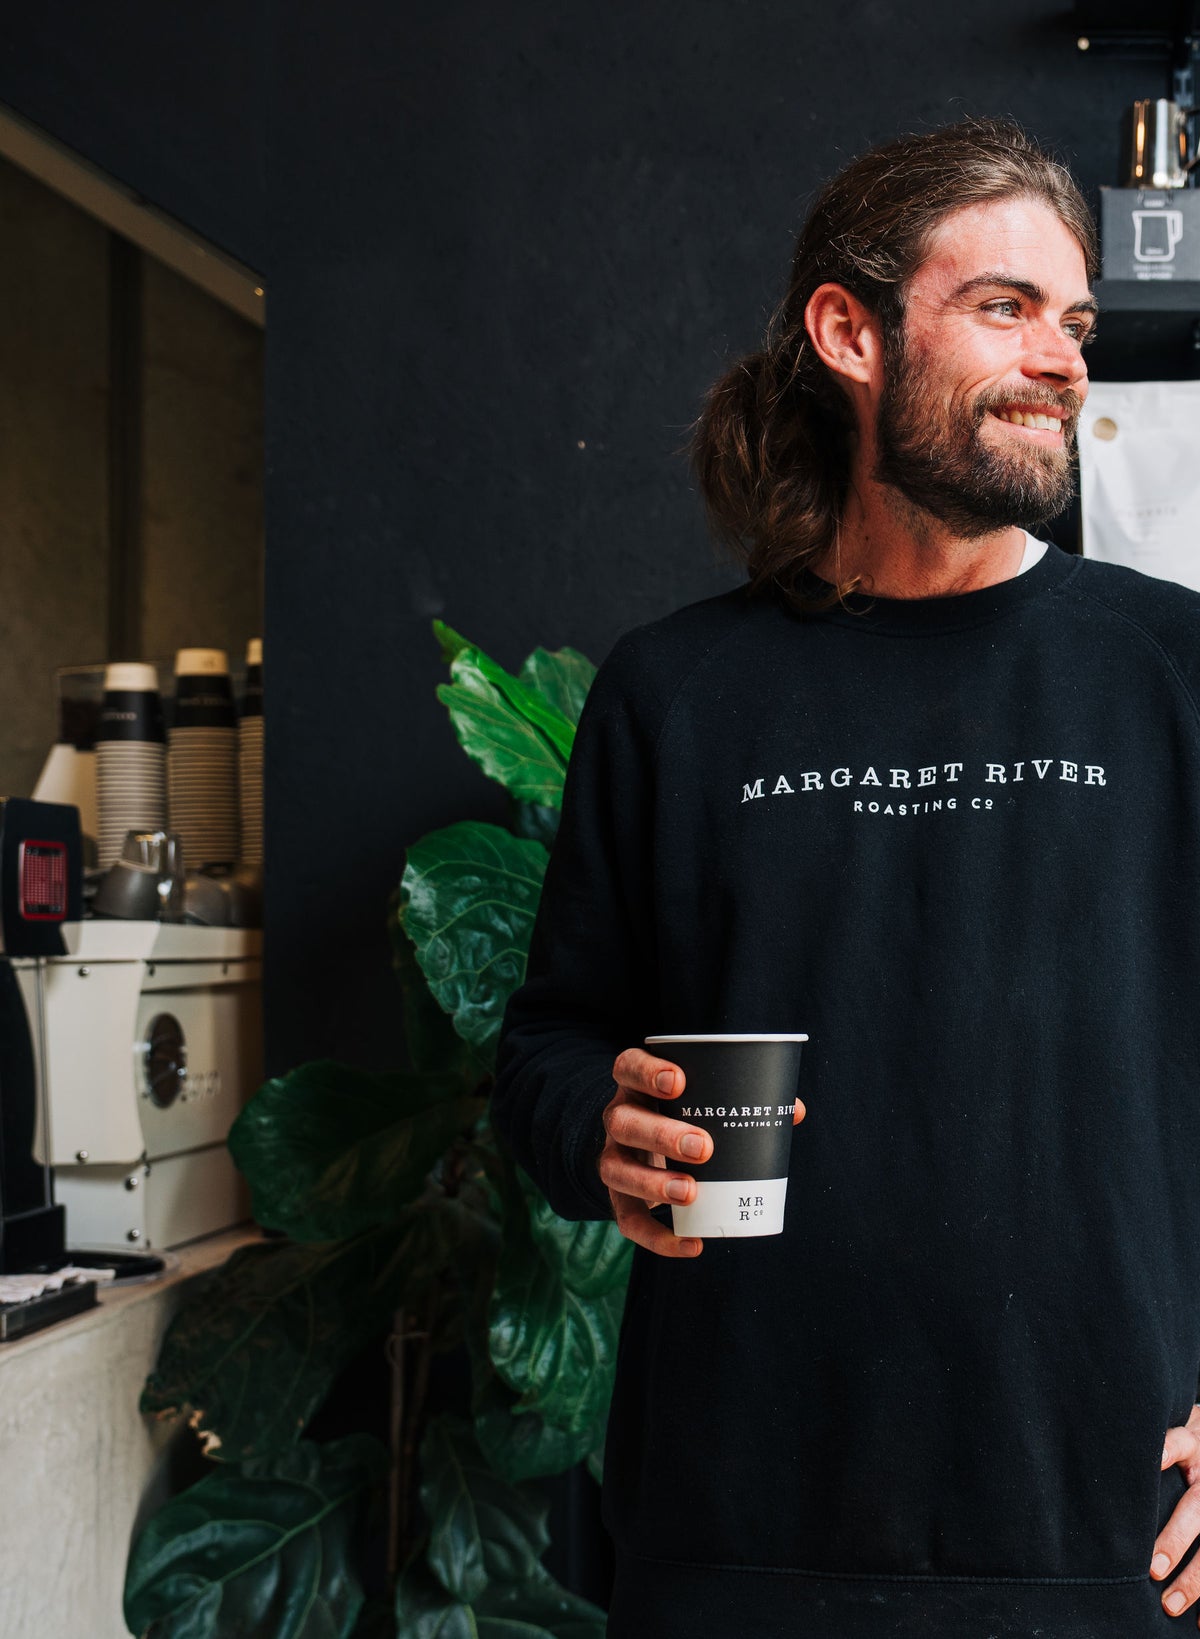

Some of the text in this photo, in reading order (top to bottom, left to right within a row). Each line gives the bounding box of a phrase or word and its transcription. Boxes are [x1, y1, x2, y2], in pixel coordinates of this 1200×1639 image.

[741, 759, 1107, 803] MARGARET RIVER
[853, 798, 957, 816] ROASTING
[682, 1106, 772, 1117] MARGARET
